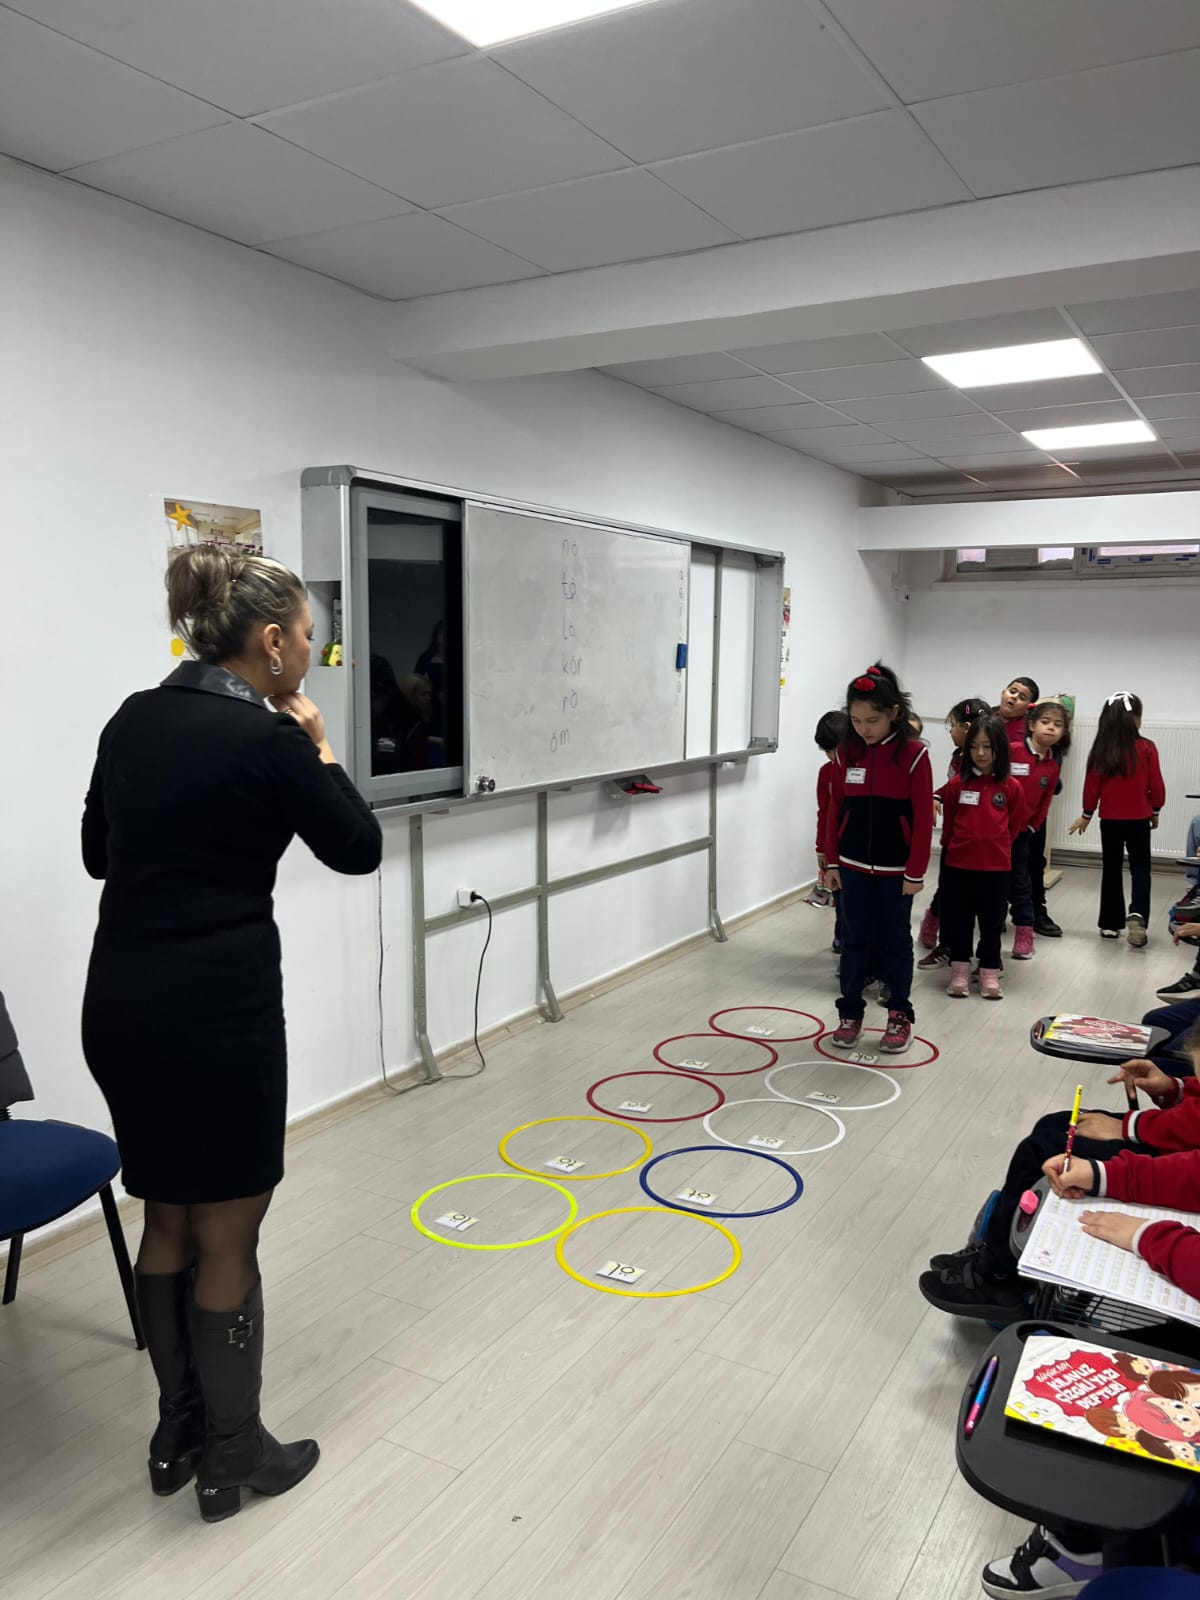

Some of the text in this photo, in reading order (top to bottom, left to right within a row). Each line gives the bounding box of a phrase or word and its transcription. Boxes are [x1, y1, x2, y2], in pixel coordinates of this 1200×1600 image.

[688, 1189, 711, 1200] öt
[449, 1213, 472, 1229] lö
[607, 1262, 636, 1277] öl
[1046, 1363, 1097, 1391] KILAVUZ
[1089, 1367, 1121, 1387] YAZI
[1075, 1380, 1128, 1409] DEFTERİ
